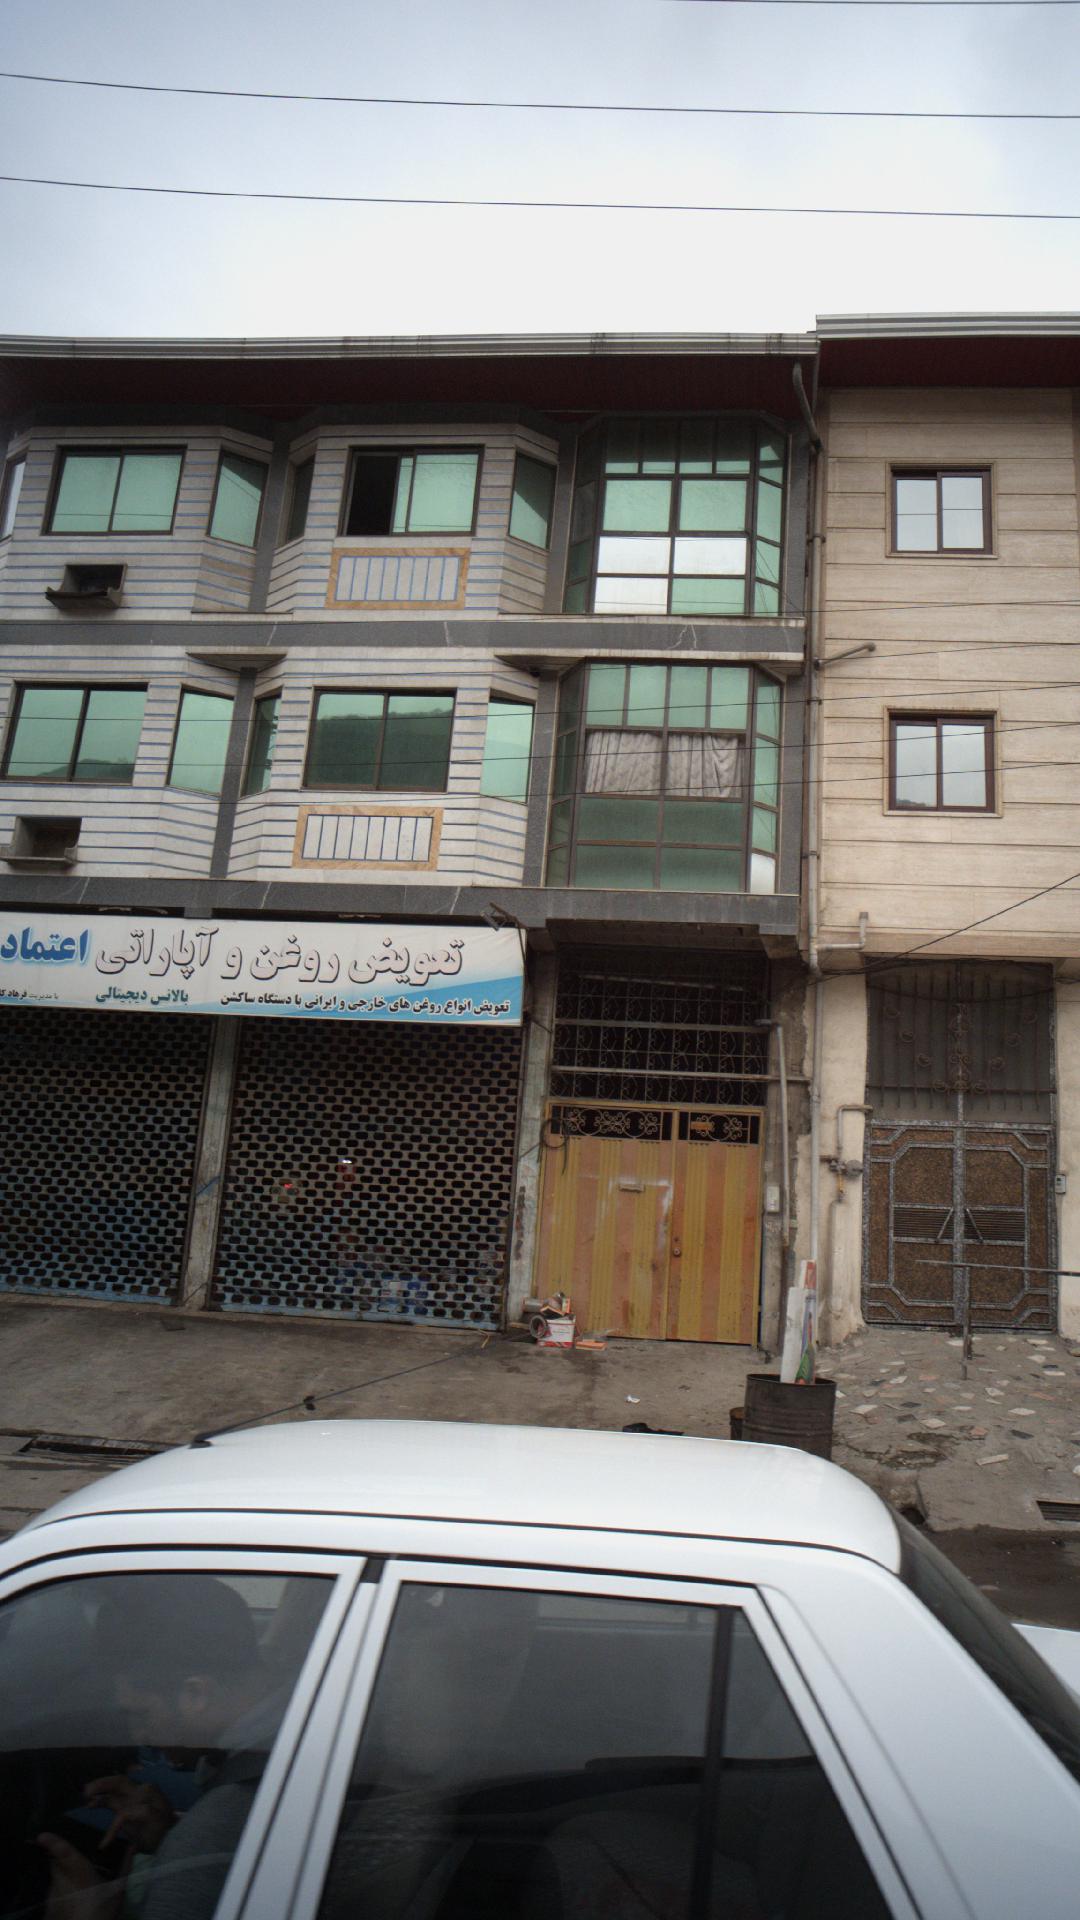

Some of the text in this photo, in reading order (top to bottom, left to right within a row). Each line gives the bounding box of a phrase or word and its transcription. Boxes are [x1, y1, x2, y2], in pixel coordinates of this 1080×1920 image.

[0, 926, 465, 986] تعویض روغن و آپاراتی اعتماد
[96, 986, 189, 1005] بالانس دیجیتالی
[220, 991, 255, 1005] ساکشن
[258, 992, 292, 1004] دستگاه
[295, 994, 302, 1006] با
[304, 995, 337, 1010] ایرانی
[347, 997, 385, 1011] خارجی
[389, 997, 410, 1012] های
[412, 998, 442, 1013] روغن
[444, 999, 471, 1014] انواع
[473, 1000, 510, 1015] تعویض
